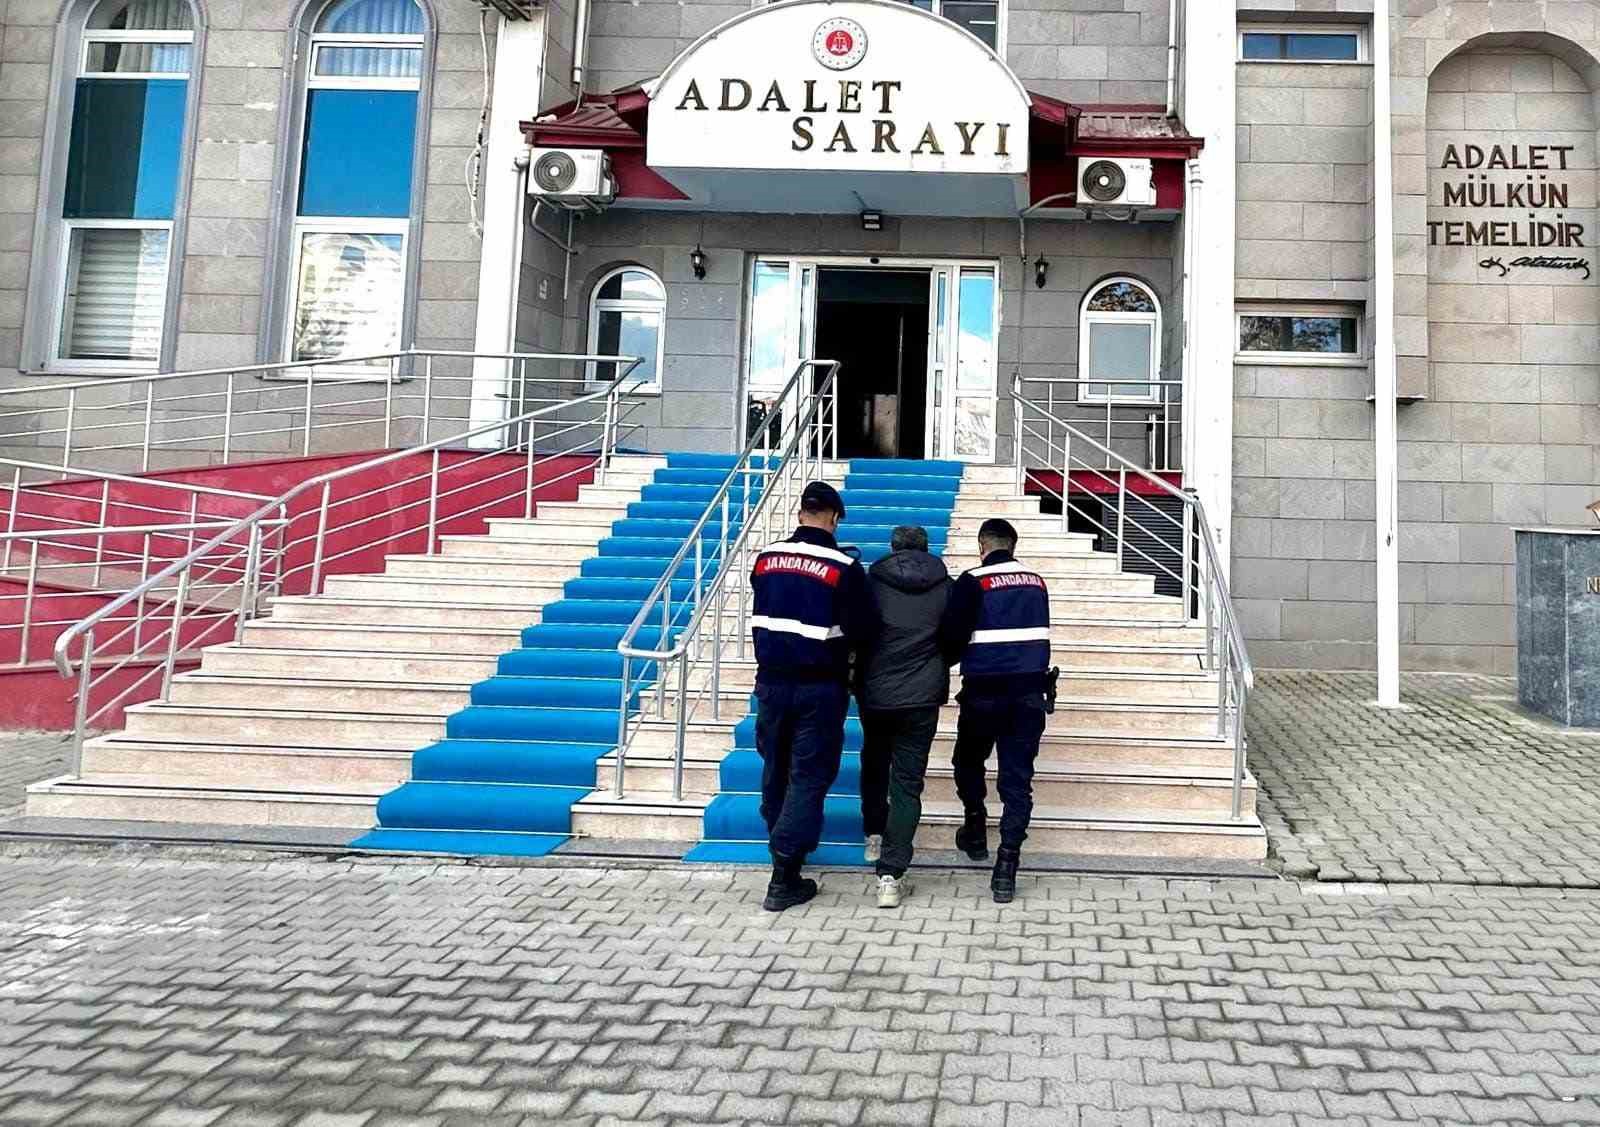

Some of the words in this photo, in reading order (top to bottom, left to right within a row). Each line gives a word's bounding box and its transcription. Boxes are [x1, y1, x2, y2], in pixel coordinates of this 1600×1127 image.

[675, 78, 902, 114] ADALET
[791, 116, 1012, 156] SARAYI
[1441, 144, 1574, 169] ADALET
[1443, 174, 1568, 208] MÜLKÜN
[1427, 213, 1584, 247] TEMELİDİR
[764, 556, 829, 579] JANDARMA
